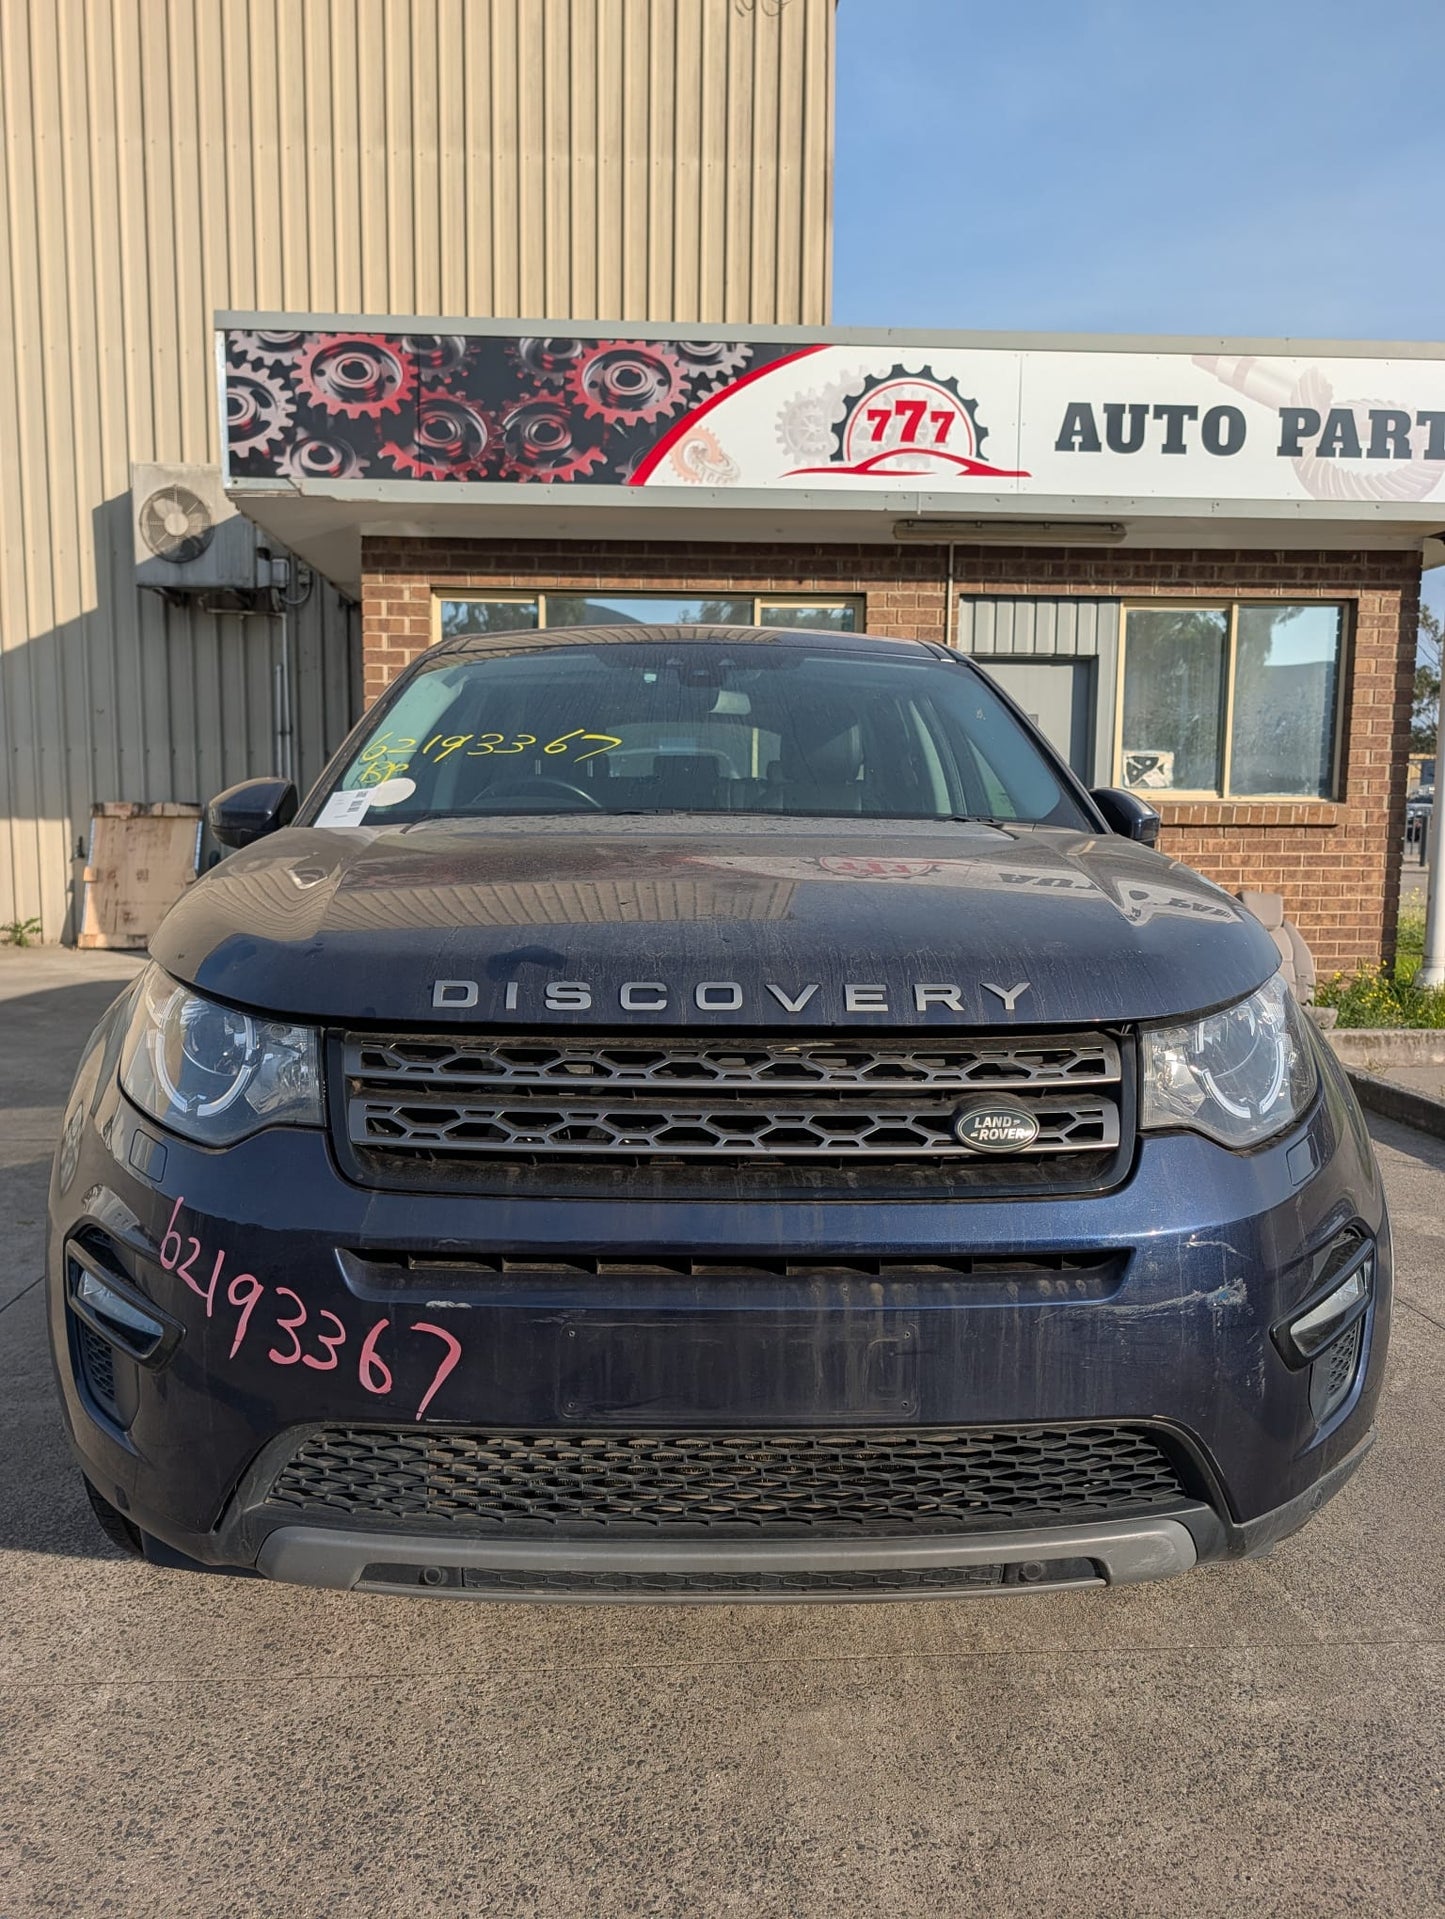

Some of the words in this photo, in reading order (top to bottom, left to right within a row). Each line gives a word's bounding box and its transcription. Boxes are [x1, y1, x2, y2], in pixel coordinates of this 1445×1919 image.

[867, 400, 955, 443] 777
[1054, 402, 1247, 456] AUTO
[1276, 407, 1445, 460] PART
[362, 728, 622, 763] 62193367
[431, 979, 1031, 1012] DISCOVERY
[974, 1116, 1012, 1128] LAND
[979, 1128, 1024, 1140] ROVER
[160, 1196, 462, 1421] 62193367
